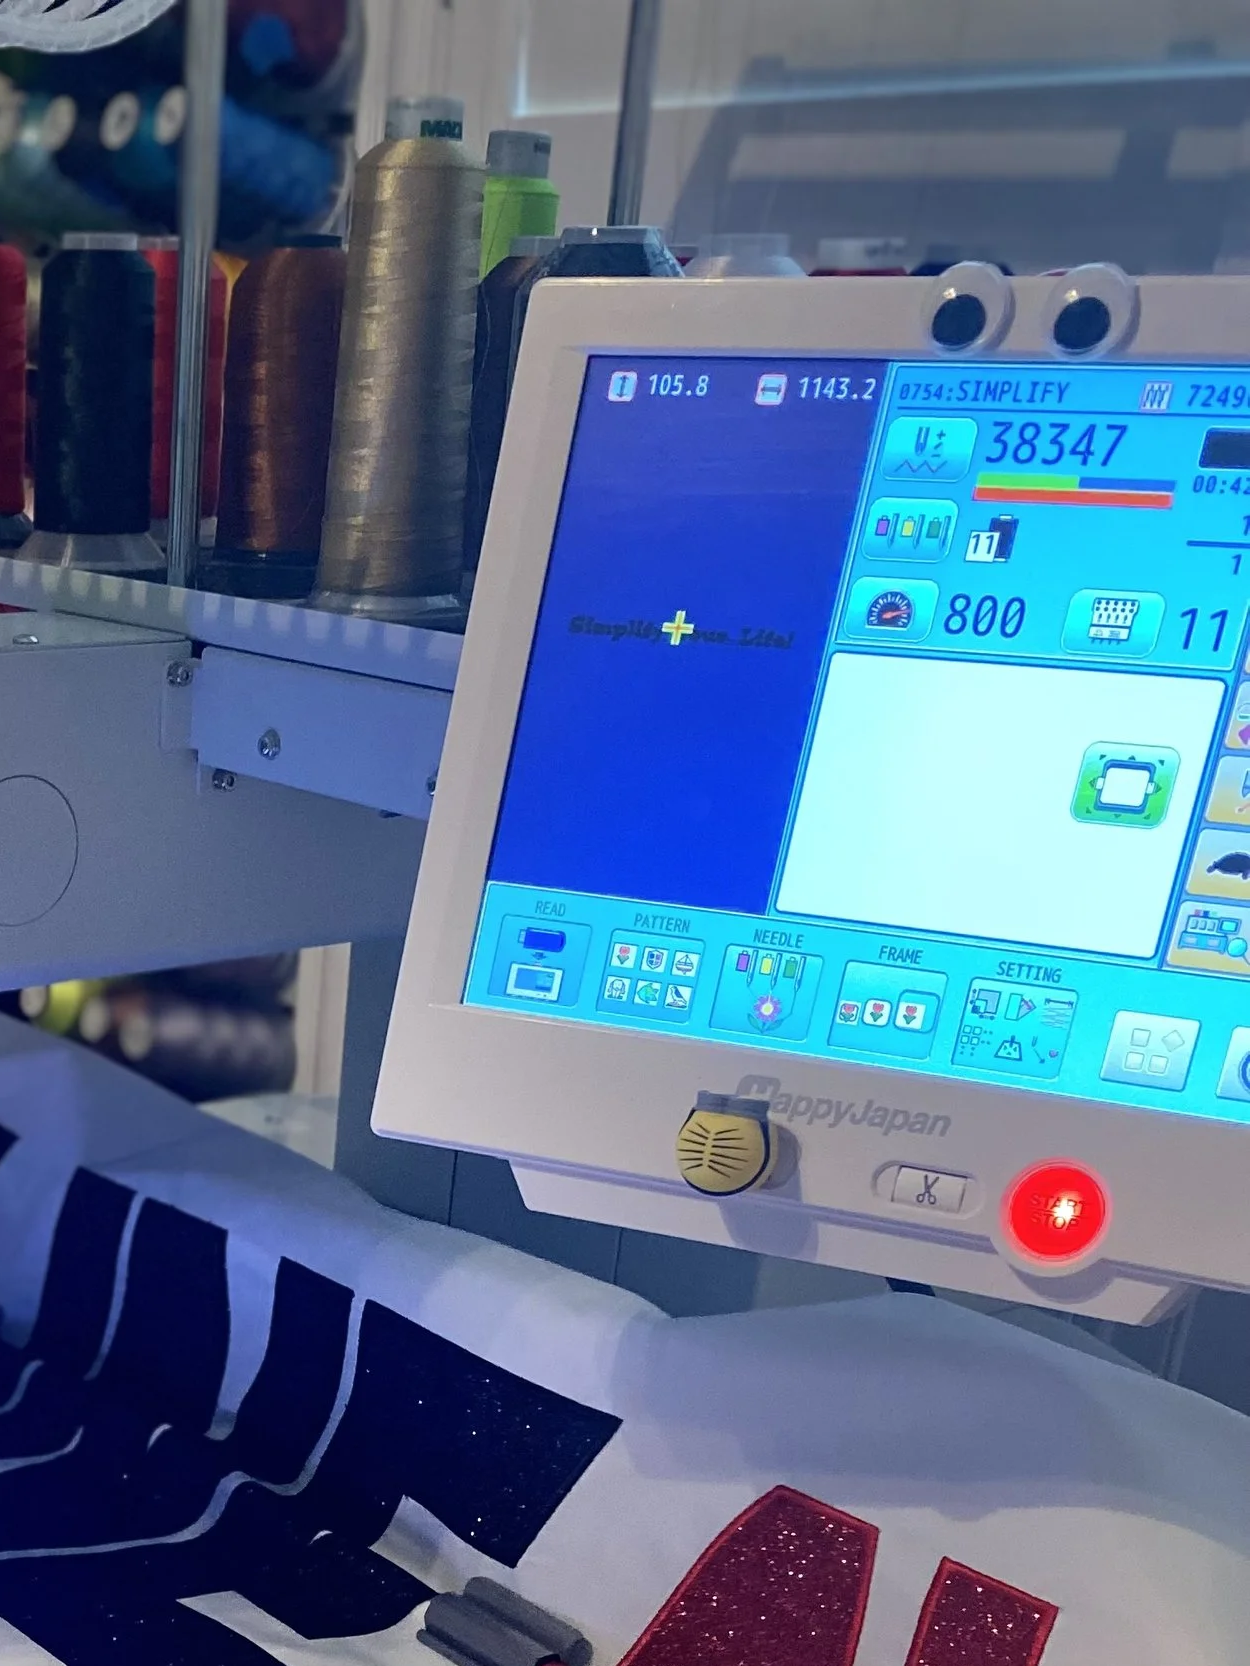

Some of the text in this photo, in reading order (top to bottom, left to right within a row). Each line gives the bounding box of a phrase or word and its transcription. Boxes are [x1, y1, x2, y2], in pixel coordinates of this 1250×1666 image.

[647, 374, 709, 397] 105.8
[797, 376, 877, 401] 1143.2
[1186, 384, 1250, 408] 7249
[985, 421, 1128, 467] 38347
[971, 533, 995, 556] 11
[943, 592, 1026, 639] 800
[1179, 606, 1229, 653] 11
[535, 900, 567, 917] READ
[633, 913, 691, 934] PATTERN
[753, 928, 805, 949] NEEDLE
[878, 945, 923, 965] FRAME
[996, 961, 1062, 983] SETTING
[1030, 1193, 1093, 1216] START
[1030, 1211, 1081, 1231] STOP
